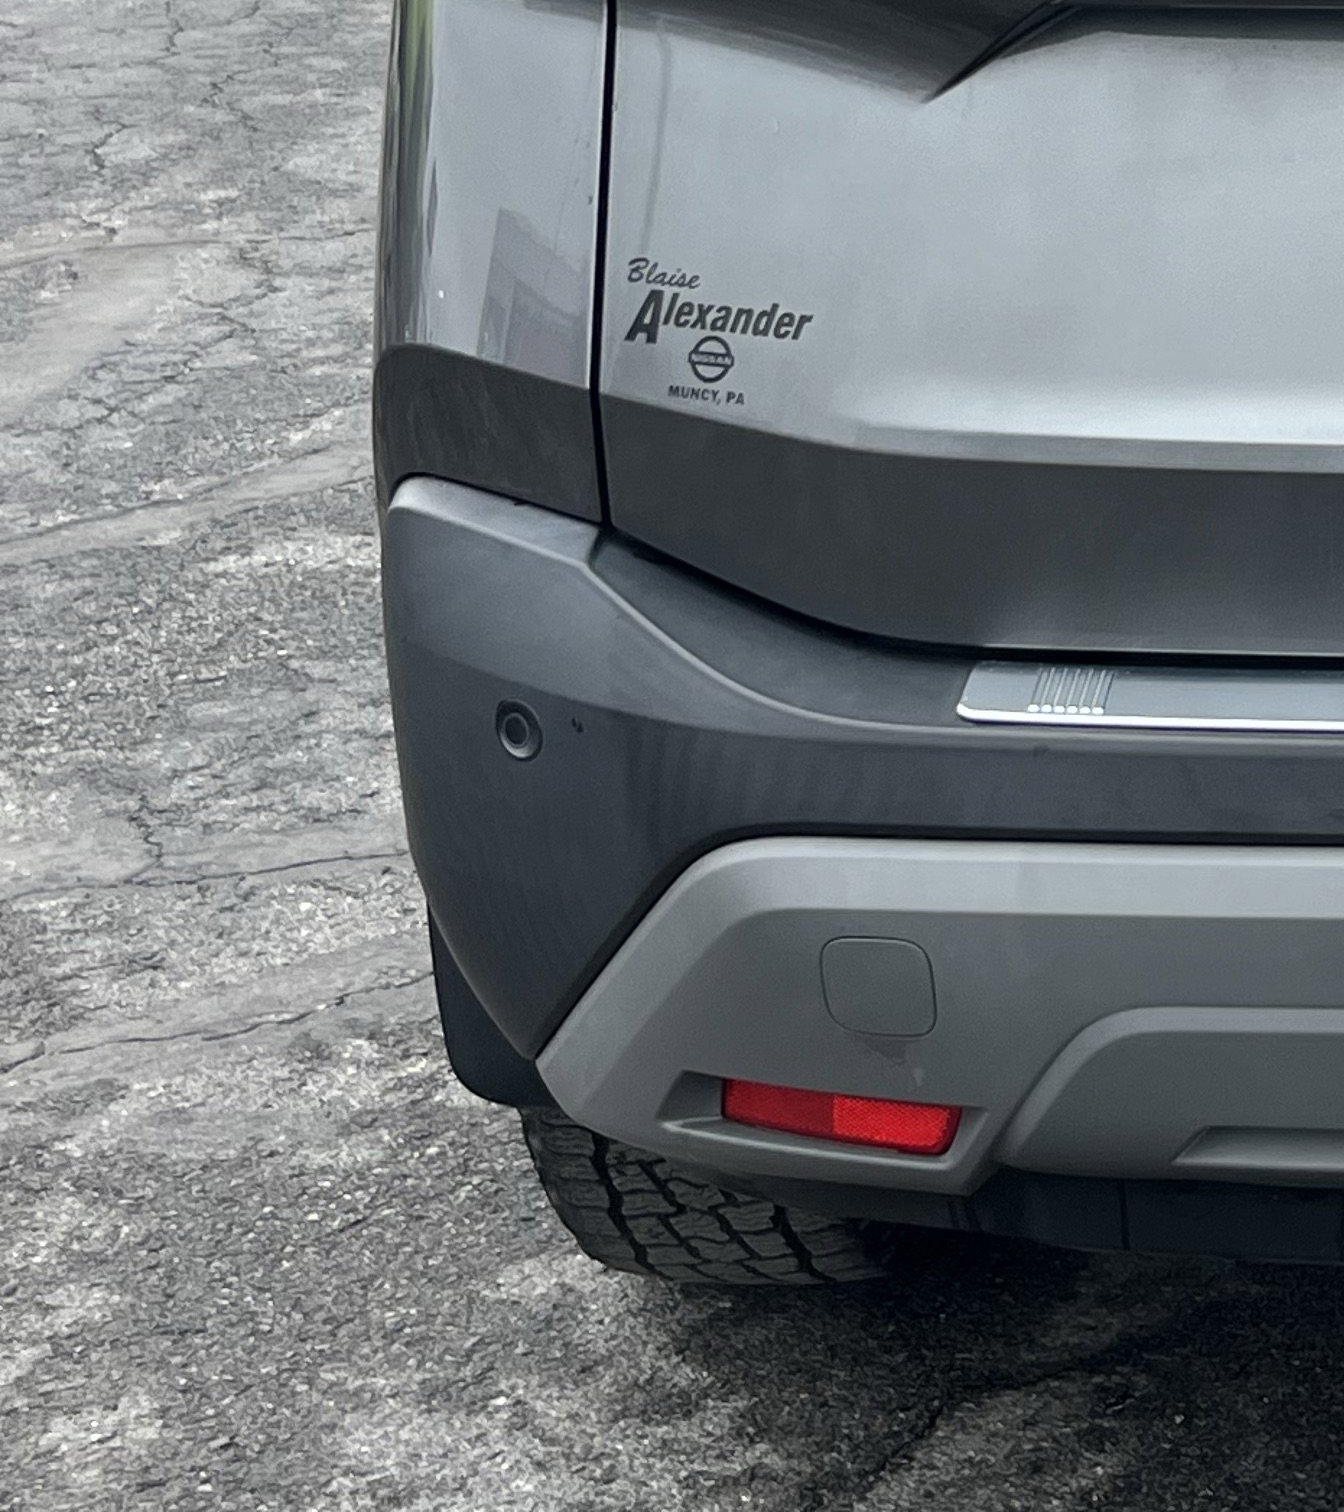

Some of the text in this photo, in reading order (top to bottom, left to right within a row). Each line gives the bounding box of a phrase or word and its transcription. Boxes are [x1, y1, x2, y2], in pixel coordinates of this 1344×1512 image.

[627, 257, 700, 289] Blaise
[624, 289, 814, 345] Alexander
[667, 385, 745, 405] MUNCY, PA
